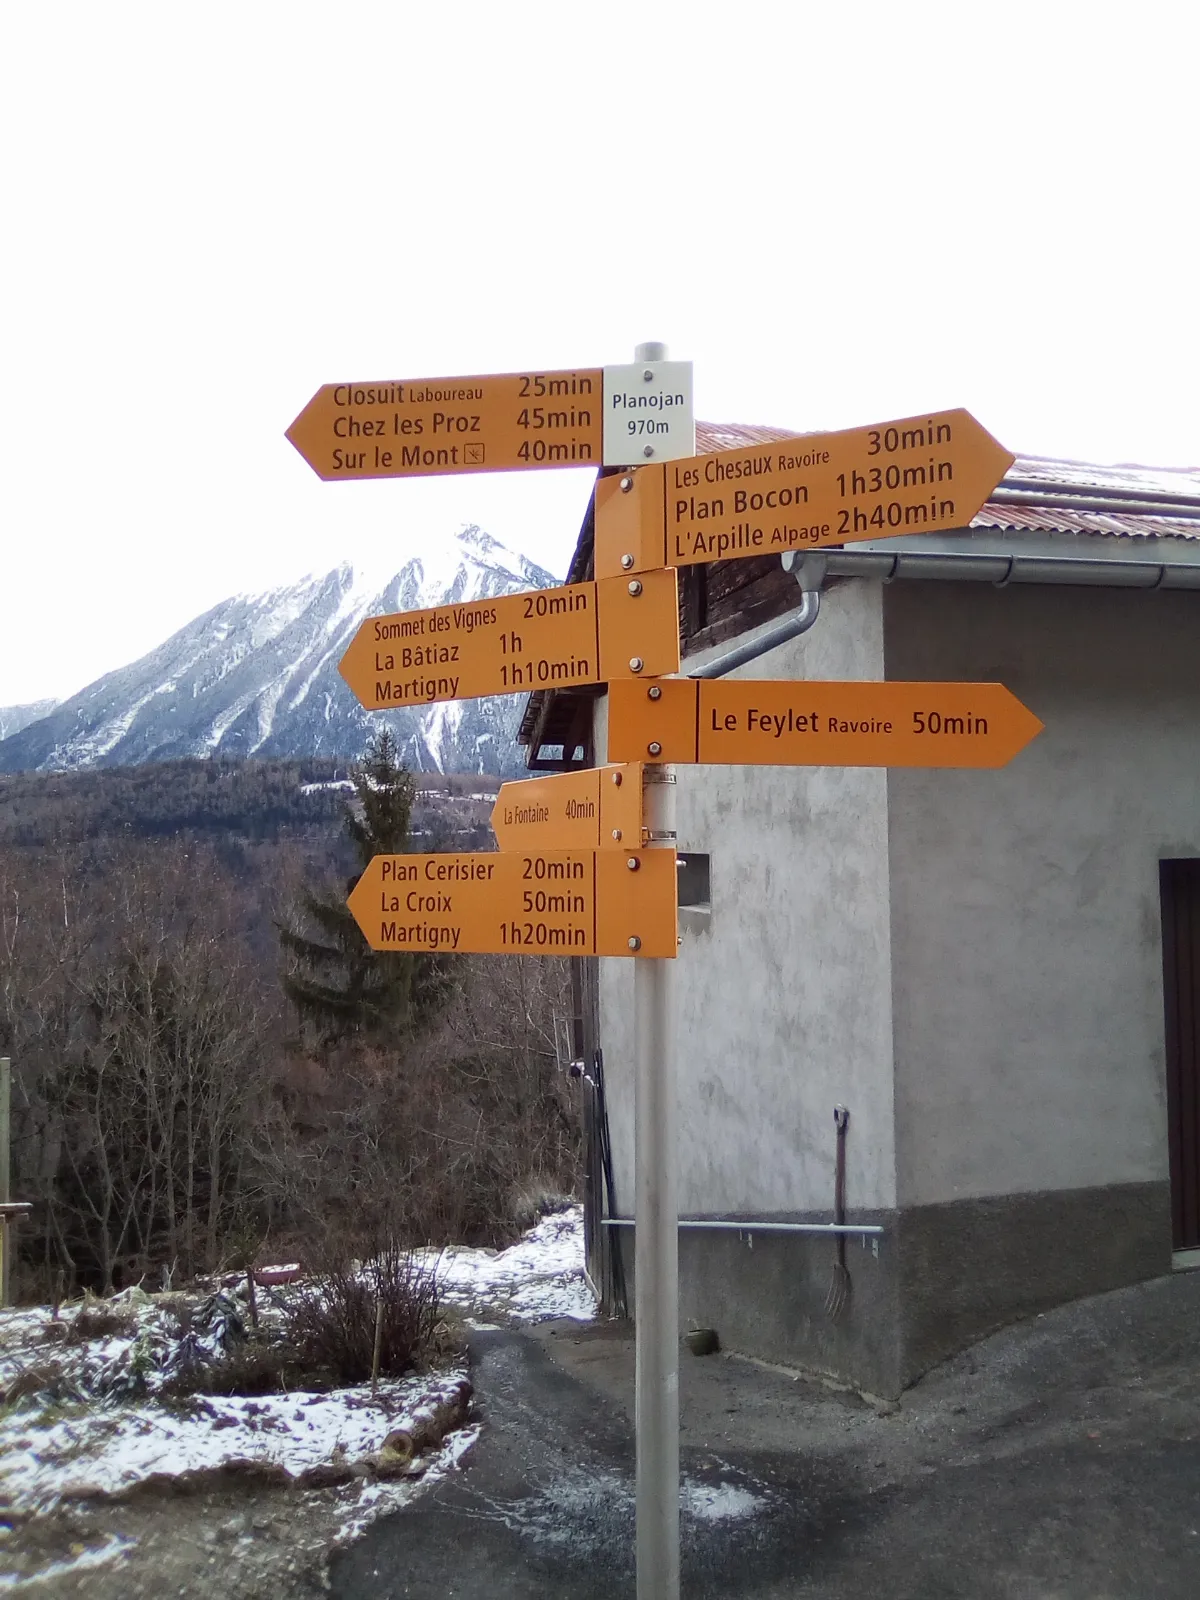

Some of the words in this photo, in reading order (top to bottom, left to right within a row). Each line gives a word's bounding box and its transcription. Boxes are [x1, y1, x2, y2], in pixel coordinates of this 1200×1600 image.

[333, 383, 405, 407] Closuit
[409, 387, 483, 403] Laboureau
[518, 373, 592, 398] 25min
[612, 390, 684, 411] Planojan
[333, 415, 386, 438] Chez
[394, 413, 424, 435] les
[433, 412, 481, 433] Proz
[516, 405, 591, 429] 45min
[627, 419, 669, 436] 970m
[332, 448, 367, 470] Sur
[375, 445, 393, 468] le
[401, 445, 459, 467] Mont
[517, 438, 592, 462] 40min
[675, 467, 700, 489] Les
[704, 455, 772, 483] Chesaux
[778, 448, 830, 471] Ravoire
[867, 419, 951, 456] 30min
[676, 496, 724, 523] Plan
[734, 485, 808, 514] Bocon
[836, 459, 953, 498] 1h30min
[675, 523, 764, 557] L'Arpille
[770, 524, 830, 546] Alpage
[836, 496, 955, 535] 2h40min
[374, 616, 425, 642] Sommet
[428, 611, 451, 633] des
[452, 607, 497, 634] Vignes
[523, 590, 587, 619] 20min
[375, 652, 394, 672] La
[402, 643, 460, 668] Bâtiaz
[499, 631, 522, 655] 1h
[375, 675, 460, 702] Martigny
[500, 655, 589, 686] 1h10min
[711, 708, 737, 732] Le
[747, 708, 819, 739] Feylet
[828, 717, 893, 734] Ravoire
[913, 711, 988, 735] 50min
[504, 807, 513, 825] La
[514, 802, 549, 825] Fontaine
[565, 796, 595, 819] 40min
[382, 860, 418, 882] Plan
[424, 859, 495, 881] Cerisier
[522, 856, 584, 880] 20min
[381, 891, 400, 912] La
[406, 890, 452, 912] Croix
[523, 889, 585, 913] 50min
[381, 921, 461, 949] Martigny
[499, 921, 586, 946] 1h20min
